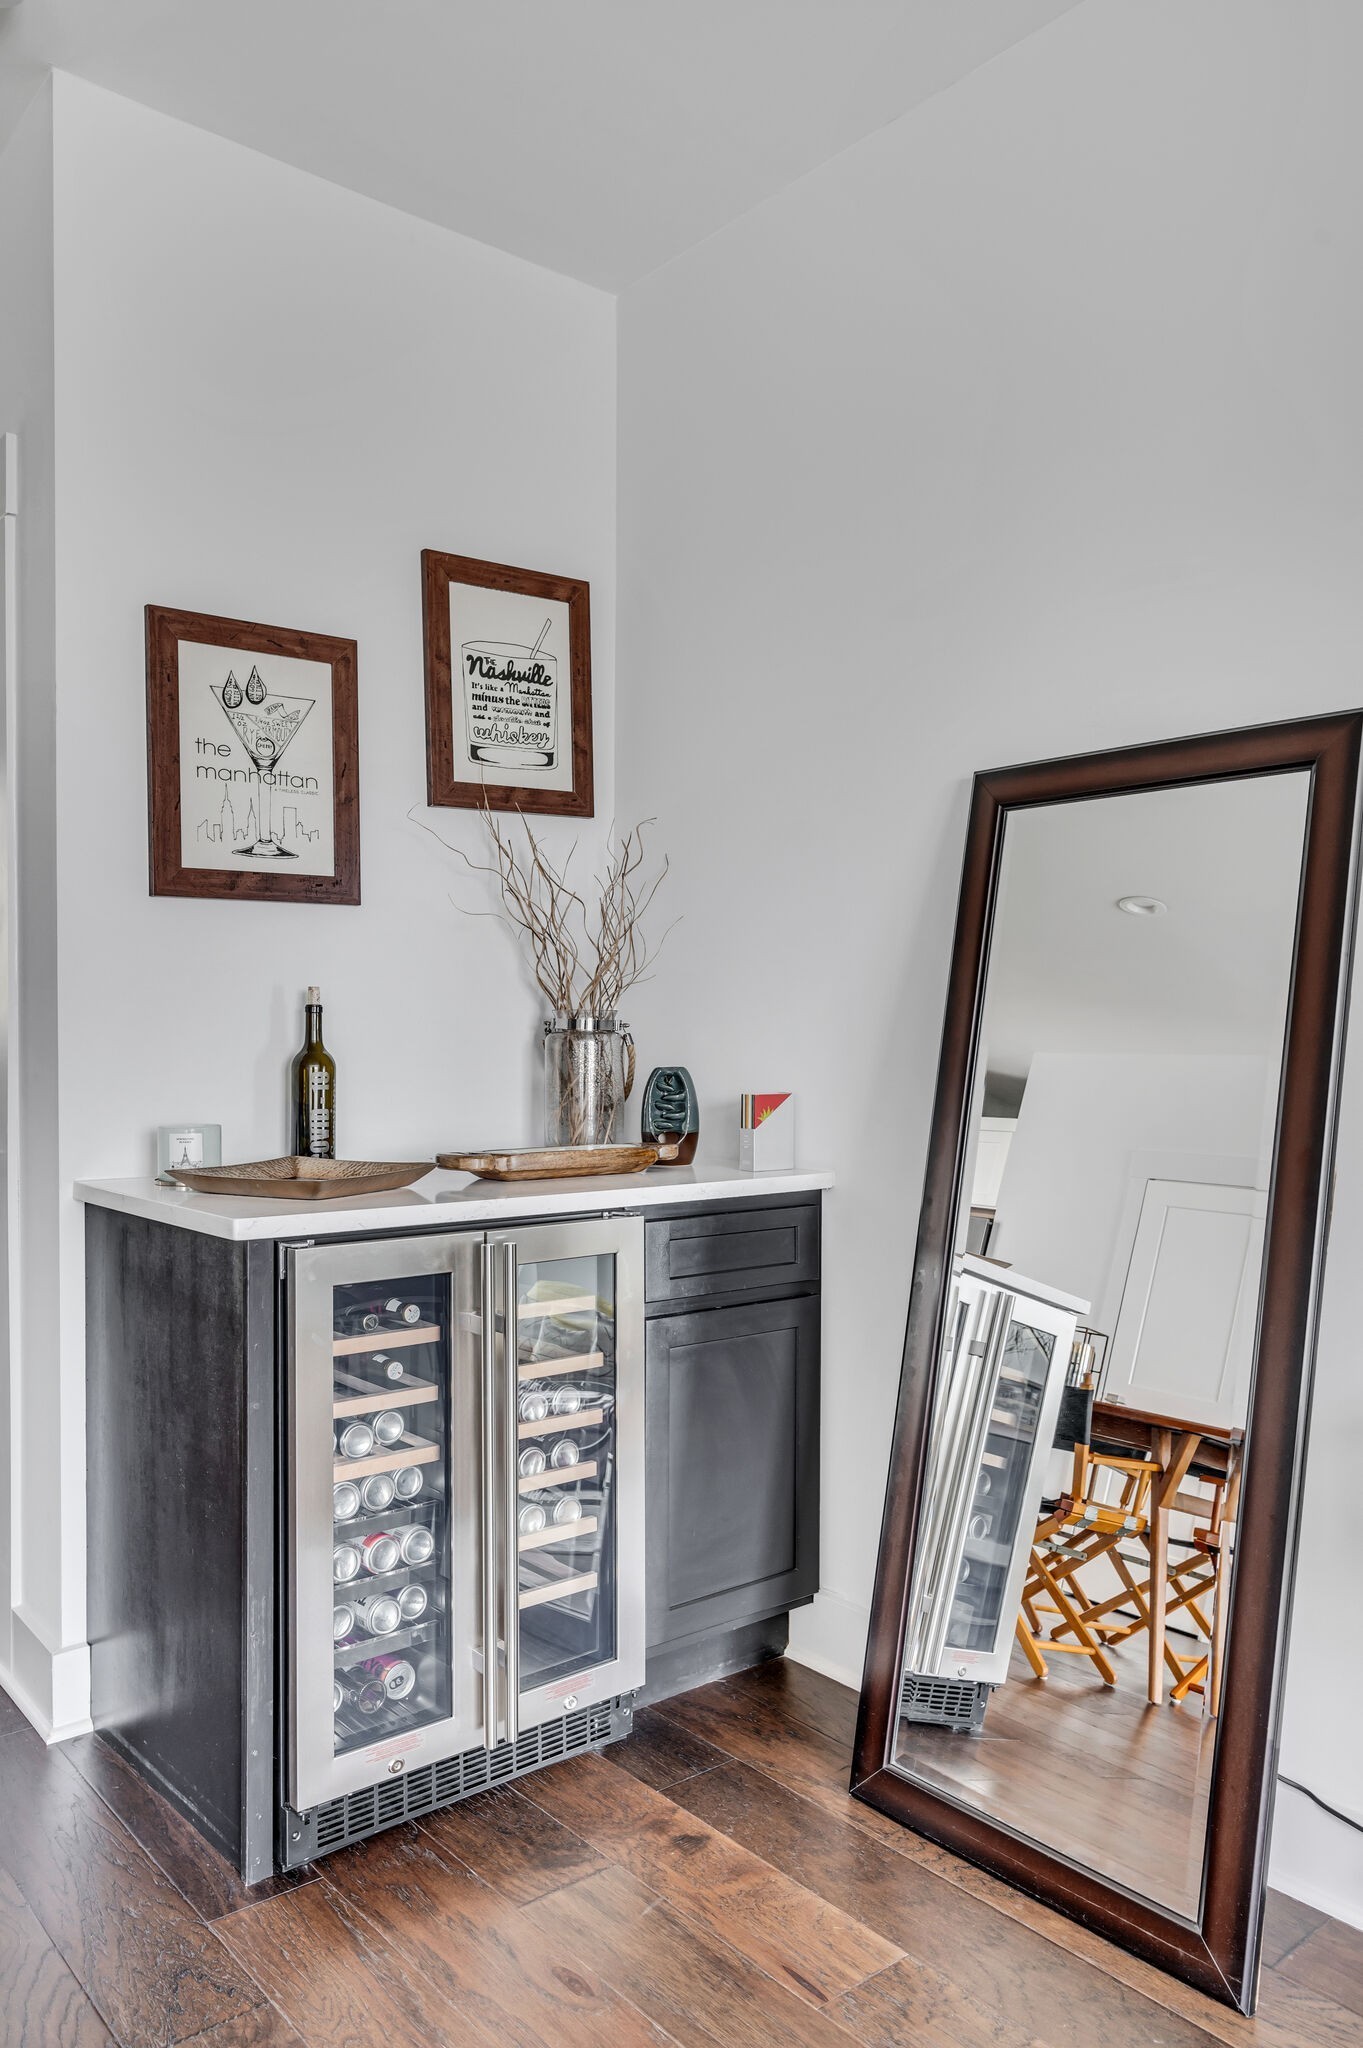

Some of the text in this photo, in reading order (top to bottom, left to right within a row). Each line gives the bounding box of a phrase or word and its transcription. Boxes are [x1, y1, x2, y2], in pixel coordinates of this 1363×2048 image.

[466, 654, 554, 687] Nashville
[471, 681, 483, 690] It's
[484, 683, 498, 692] like
[471, 691, 505, 704] minus
[505, 695, 521, 706] the
[471, 703, 488, 712] and
[534, 710, 550, 719] and
[473, 723, 550, 749] whiskey
[194, 737, 232, 757] the
[196, 765, 319, 790] manhattan
